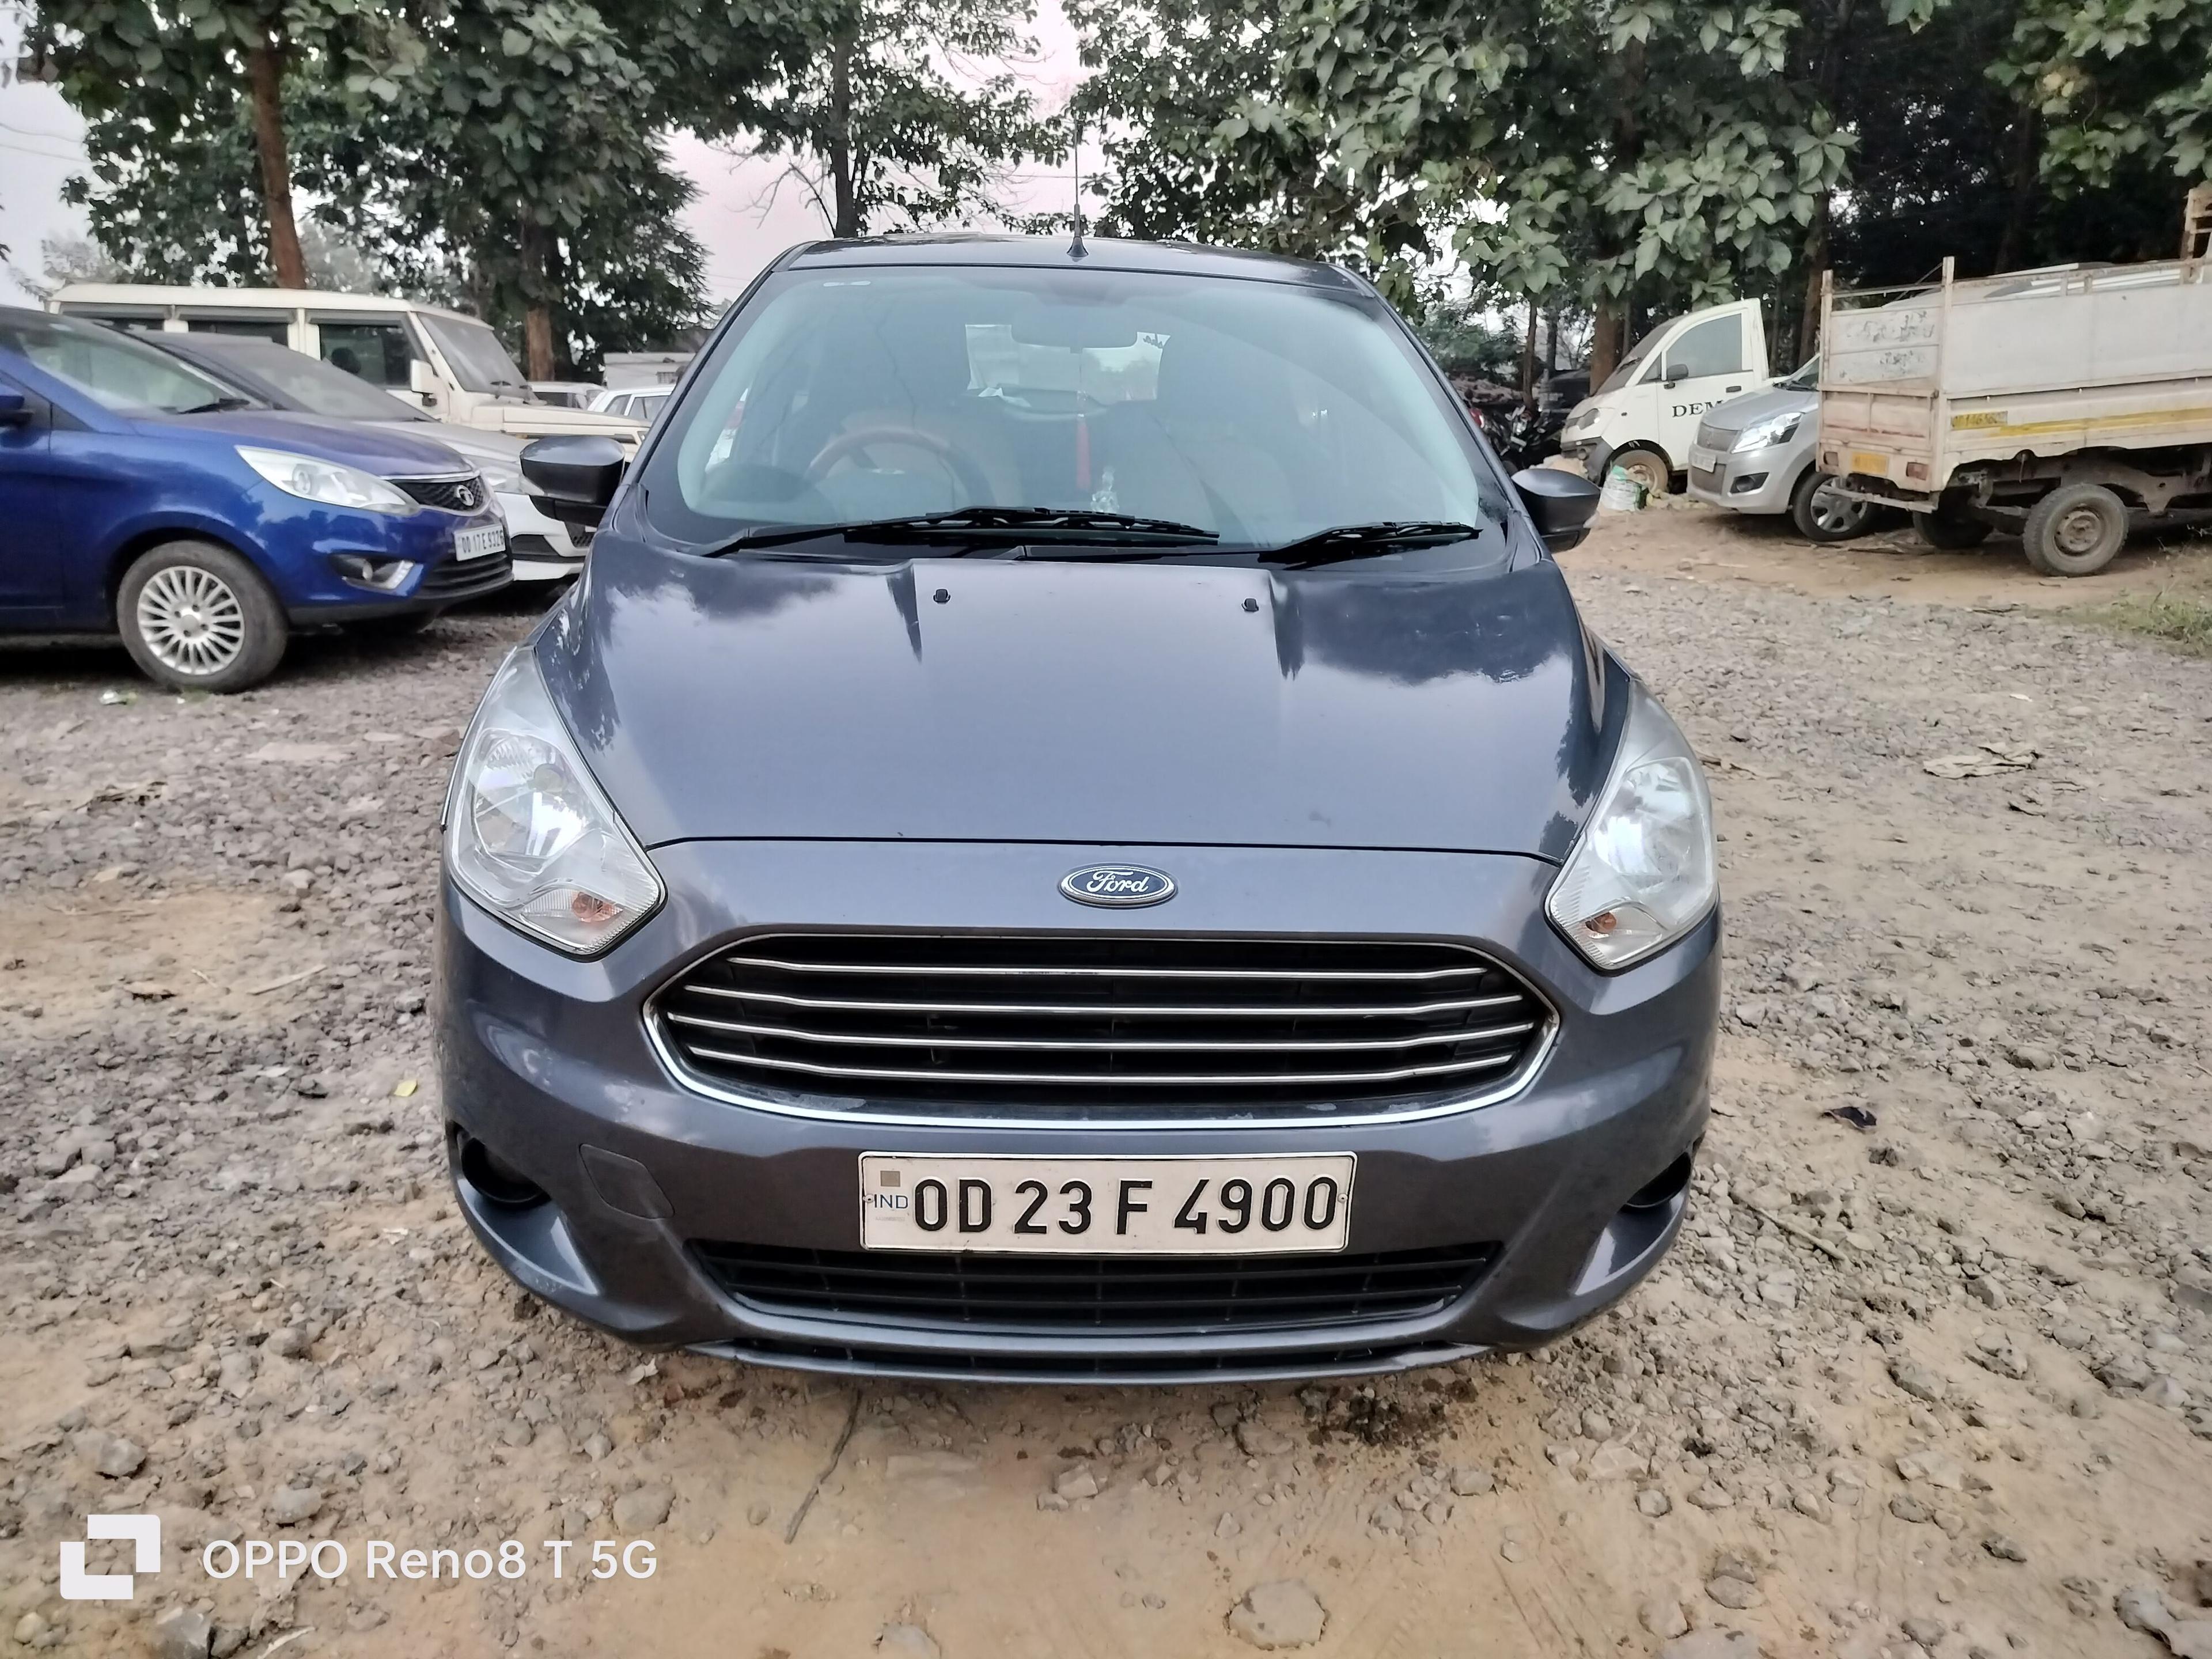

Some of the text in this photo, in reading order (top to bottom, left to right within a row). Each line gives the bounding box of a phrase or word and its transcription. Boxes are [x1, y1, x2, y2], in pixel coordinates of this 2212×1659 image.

[1086, 870, 1150, 892] Ford
[874, 1194, 908, 1209] IND
[915, 1177, 1338, 1235] OD 23 F 4900
